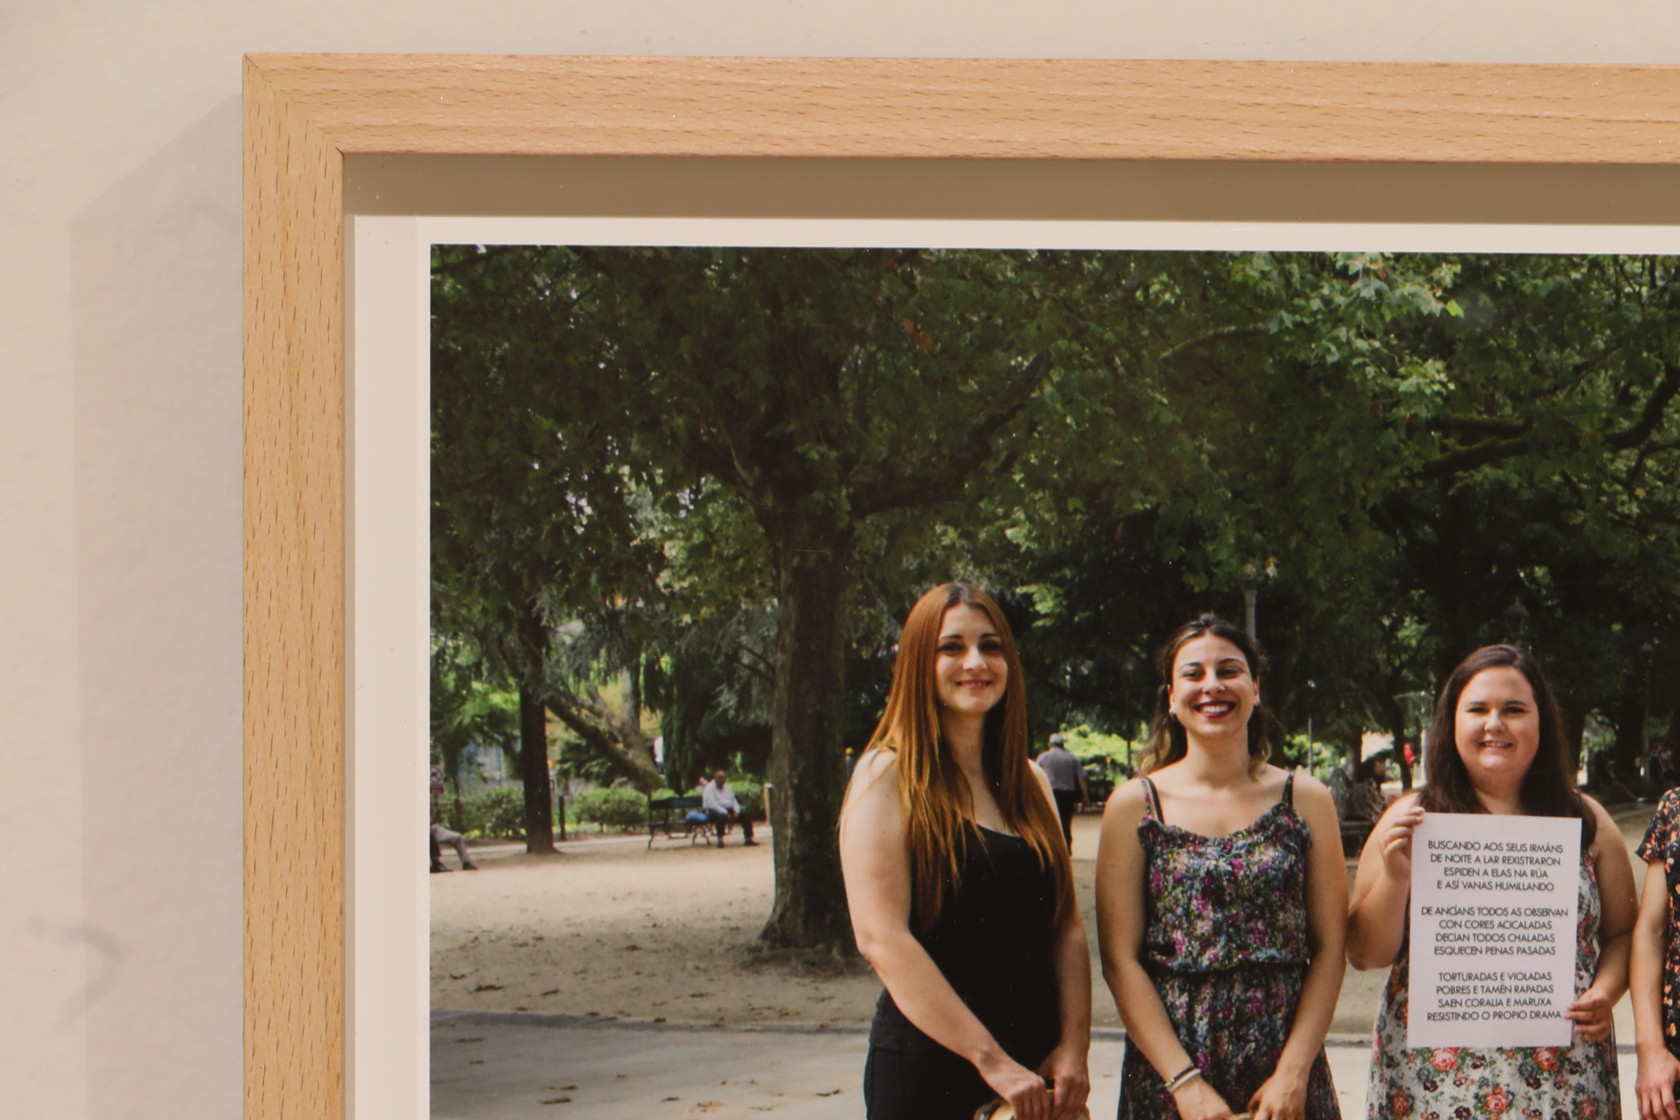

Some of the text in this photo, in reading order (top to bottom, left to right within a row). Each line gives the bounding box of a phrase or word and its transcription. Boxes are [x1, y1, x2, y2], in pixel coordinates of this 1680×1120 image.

[1428, 840, 1481, 851] BUSCANDO
[1483, 842, 1504, 851] AOS
[1506, 842, 1527, 853] SEUS
[1430, 854, 1561, 866] DE NOITE A LAR REXISTRARON
[1444, 867, 1480, 877] ESPIDEN
[1482, 868, 1489, 877] A
[1491, 868, 1512, 878] ELAS
[1514, 869, 1527, 878] NA
[1437, 880, 1442, 889] E
[1495, 882, 1555, 892] HUMILLANDO
[1421, 906, 1433, 916] DE
[1477, 907, 1509, 917] TODOS
[1510, 908, 1522, 917] AS
[1524, 908, 1568, 917] OBSERVAN
[1439, 920, 1552, 930] CON CORES ACICALADAS
[1472, 933, 1505, 942] TODOS
[1507, 933, 1555, 942] CHALADAS
[1434, 946, 1556, 956] ESQUECEN PENAS PASADAS
[1438, 971, 1552, 982] TORTURADAS E VIOLADAS
[1436, 985, 1471, 995] POBRES
[1473, 985, 1478, 994] E
[1514, 984, 1554, 994] RAPADAS
[1438, 997, 1552, 1008] SAEN CORALIA E MARUXA
[1427, 1010, 1562, 1021] RESISTINDO O PROPIO DRAMA
